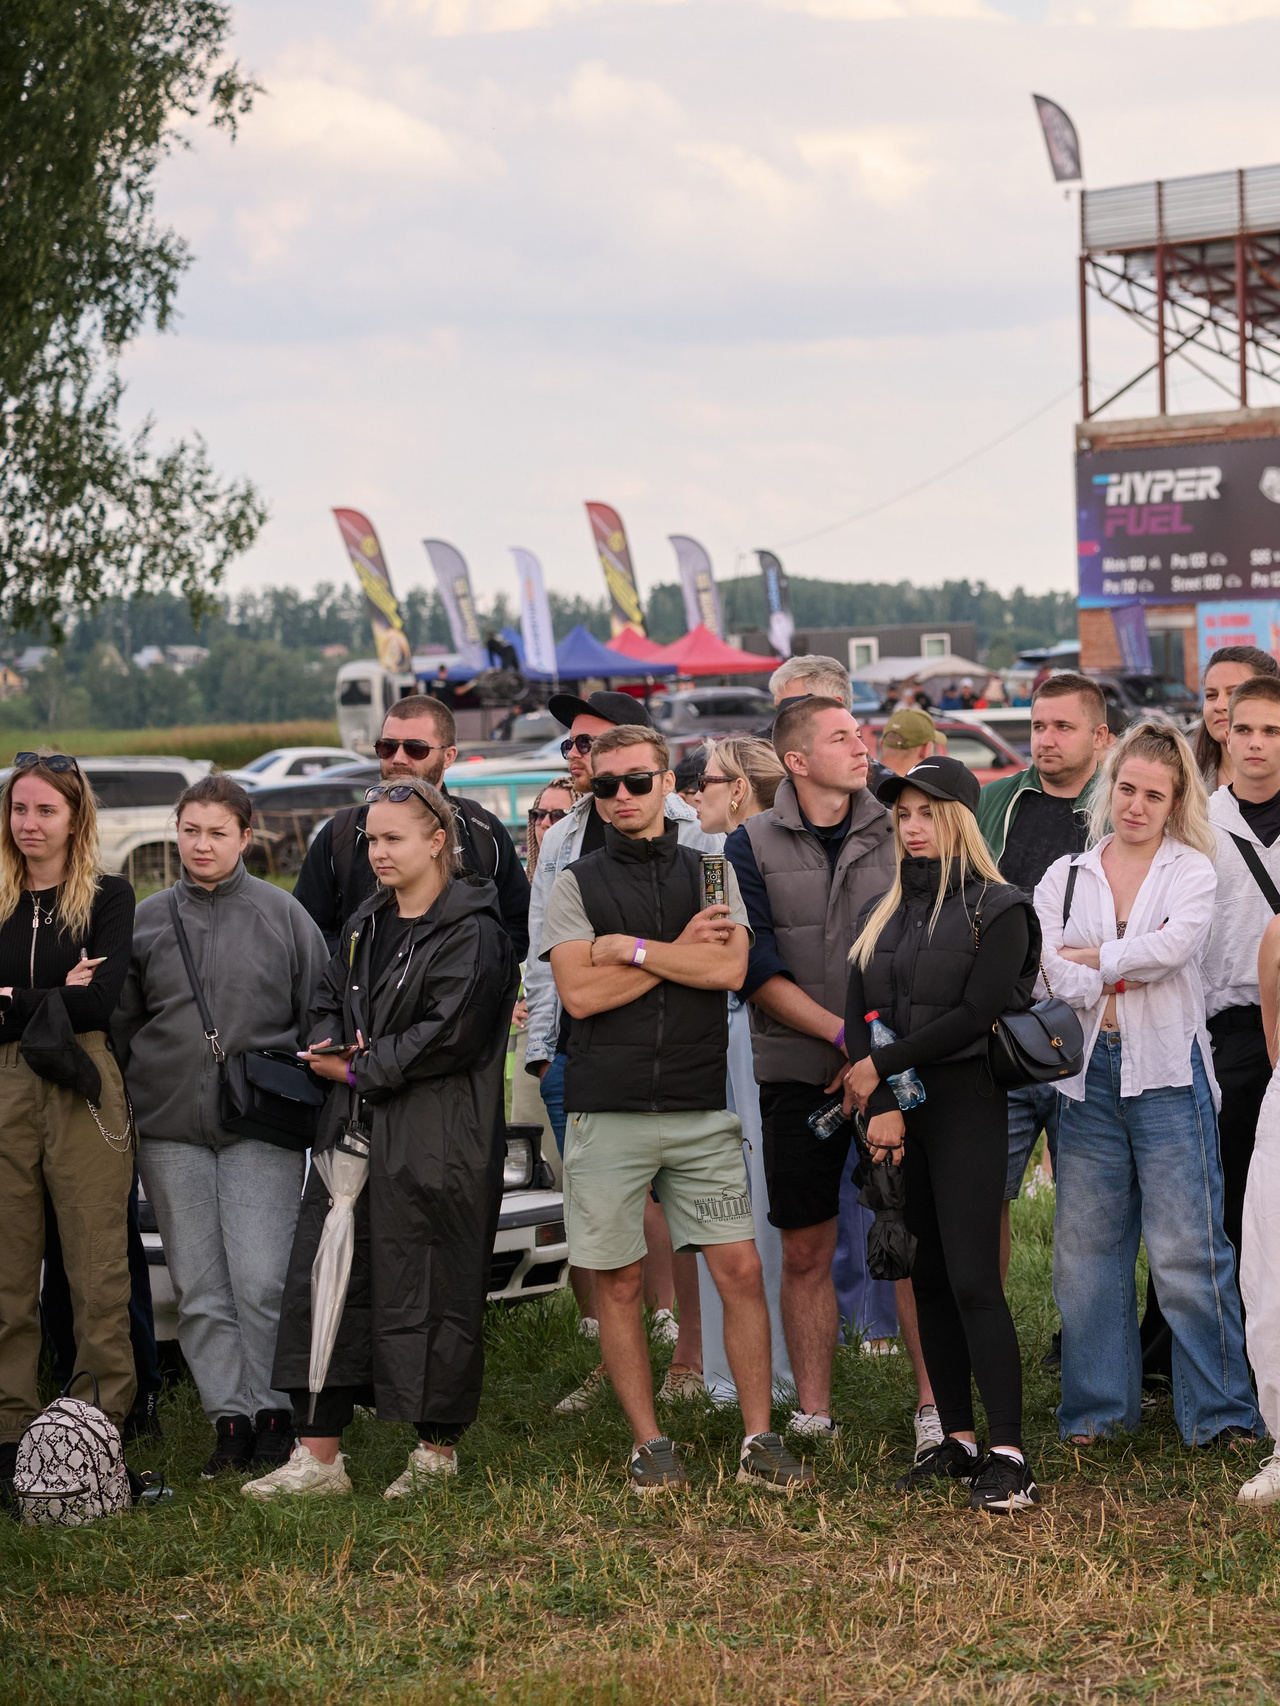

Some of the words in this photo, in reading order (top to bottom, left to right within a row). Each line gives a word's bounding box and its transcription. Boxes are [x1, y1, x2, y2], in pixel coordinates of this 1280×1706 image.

[1105, 466, 1223, 506] HYPER
[1104, 503, 1194, 538] FUEL
[1171, 575, 1200, 592] Street
[694, 1196, 751, 1221] PUMA
